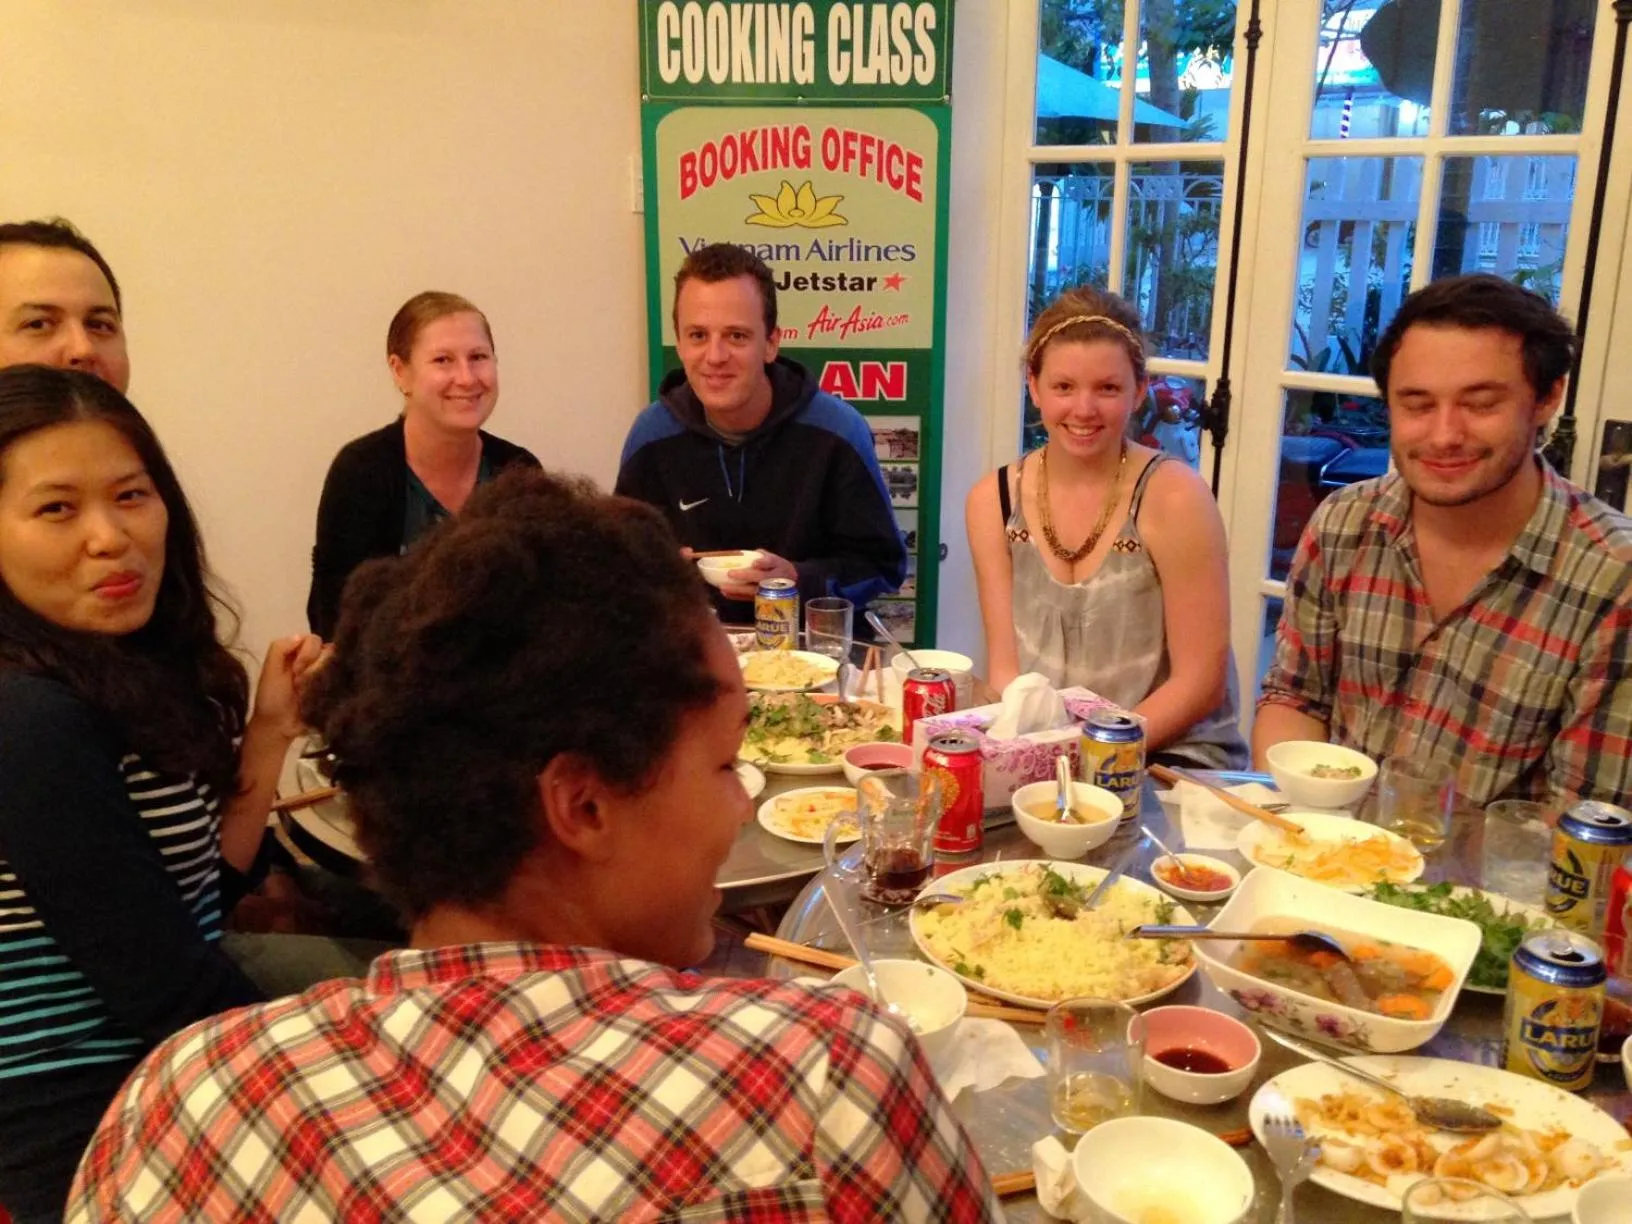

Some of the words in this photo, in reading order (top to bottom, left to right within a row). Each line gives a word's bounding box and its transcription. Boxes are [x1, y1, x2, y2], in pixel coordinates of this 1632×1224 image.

[657, 1, 815, 84] COOKING
[827, 2, 936, 85] CLASS
[679, 124, 811, 201] BOOKING
[821, 127, 923, 203] OFFICE
[805, 237, 916, 262] Airlines
[776, 271, 878, 291] Jetstar
[819, 361, 907, 400] AN
[1524, 1023, 1594, 1047] LARU
